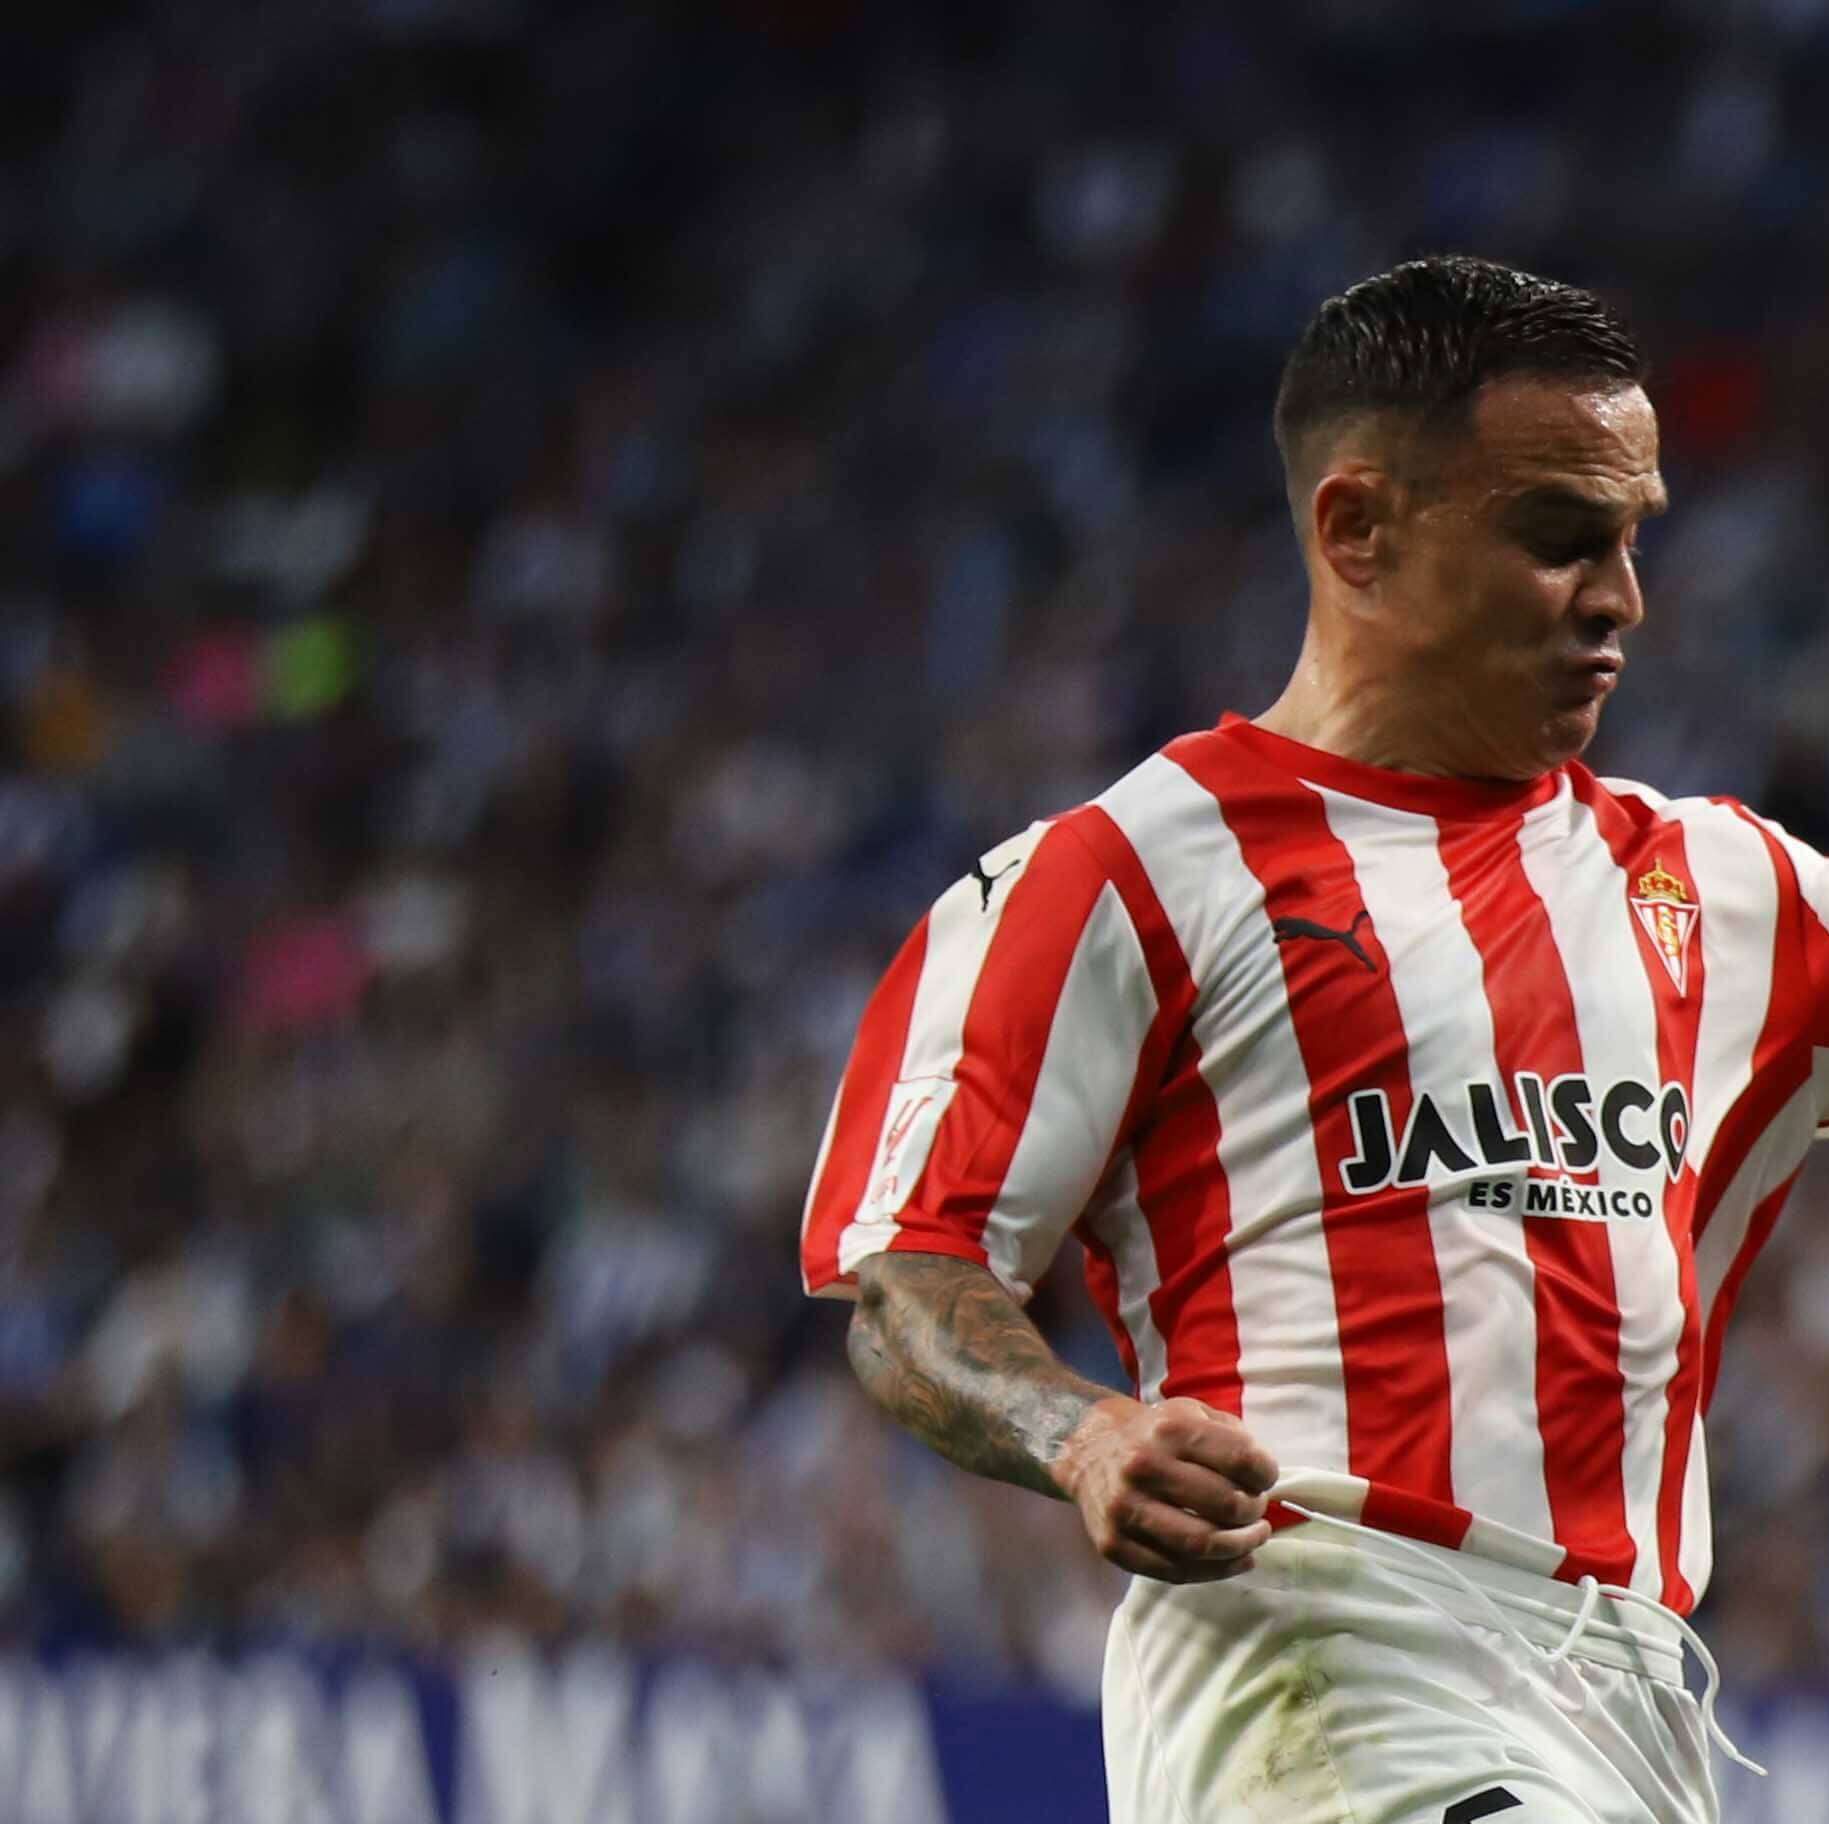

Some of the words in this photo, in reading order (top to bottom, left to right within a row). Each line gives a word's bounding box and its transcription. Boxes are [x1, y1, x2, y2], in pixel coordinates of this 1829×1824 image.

[1346, 1076, 1689, 1188] JALISCO
[1468, 1181, 1513, 1209] ES
[1526, 1179, 1652, 1218] MÉXICO
